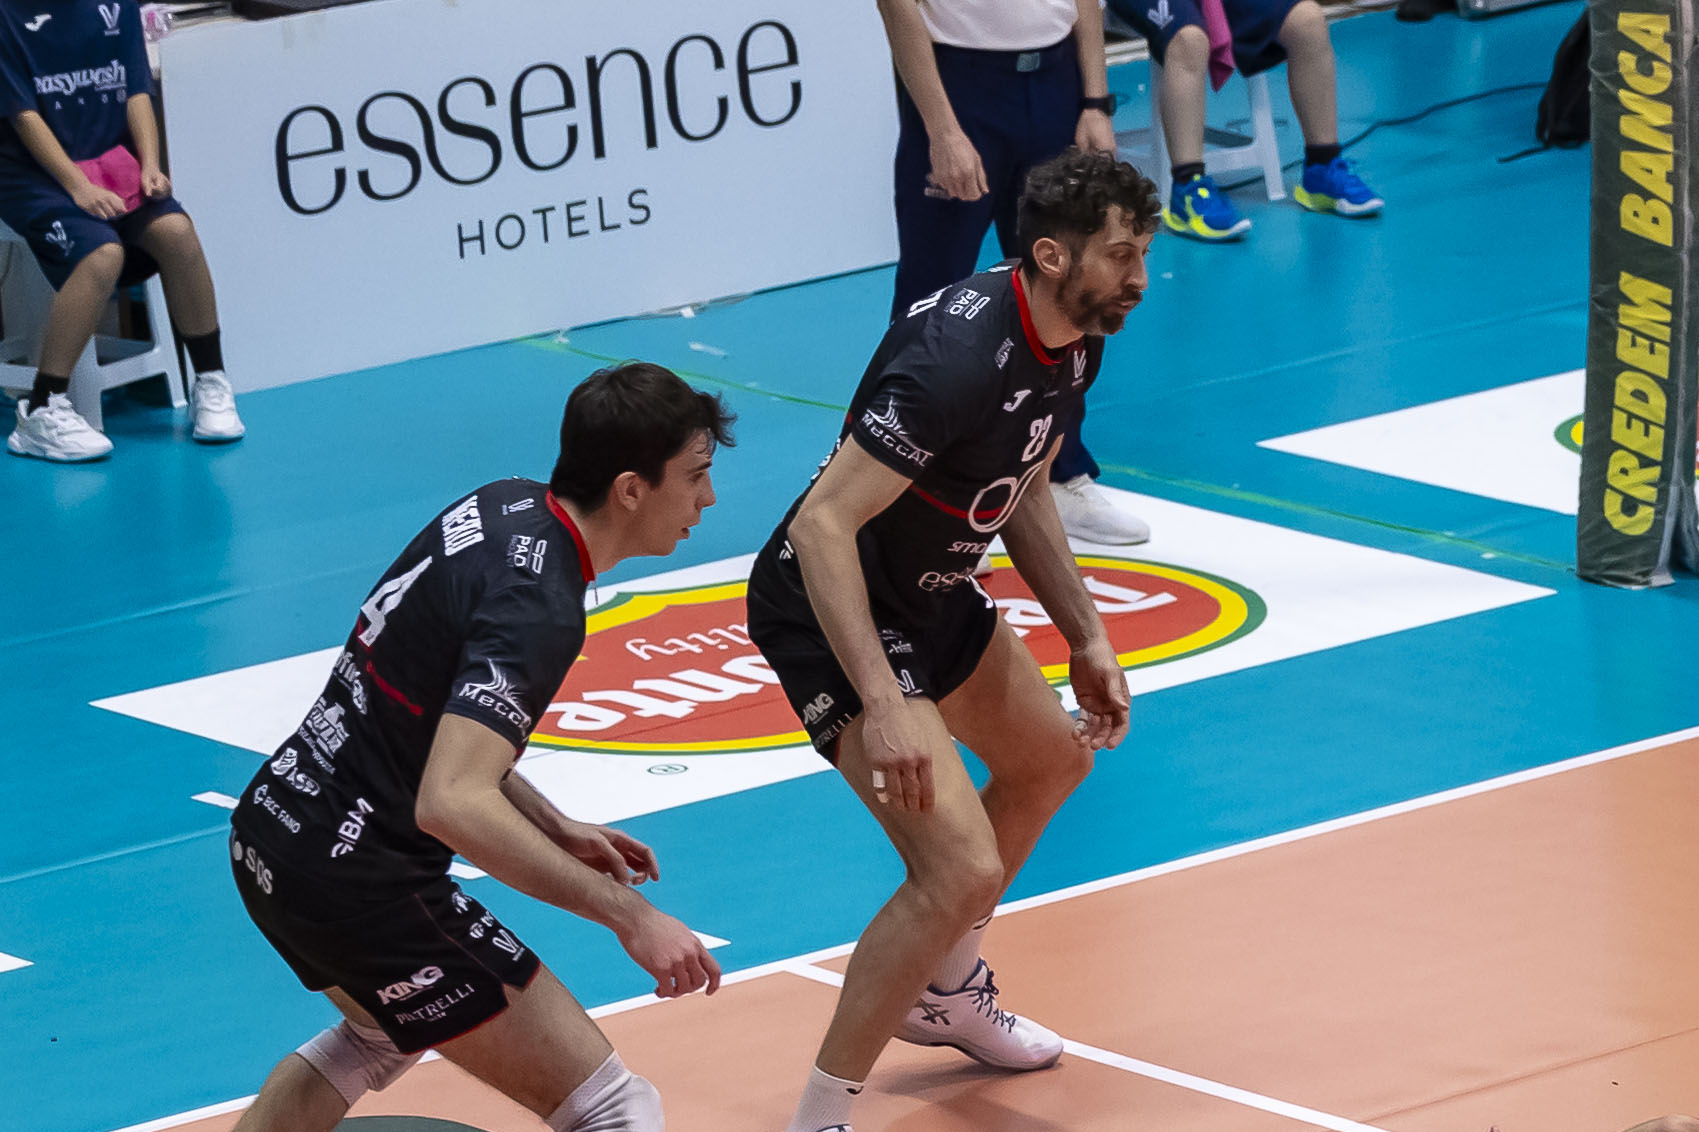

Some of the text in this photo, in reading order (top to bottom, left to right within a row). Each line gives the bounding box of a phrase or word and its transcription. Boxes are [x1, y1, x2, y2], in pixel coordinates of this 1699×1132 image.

[274, 20, 803, 216] essence
[456, 187, 654, 260] HOTELS
[1604, 11, 1674, 536] CREDEM BANCA
[358, 555, 433, 648] 4
[624, 622, 748, 663] ality
[547, 652, 780, 733] onte
[376, 964, 446, 1006] KING
